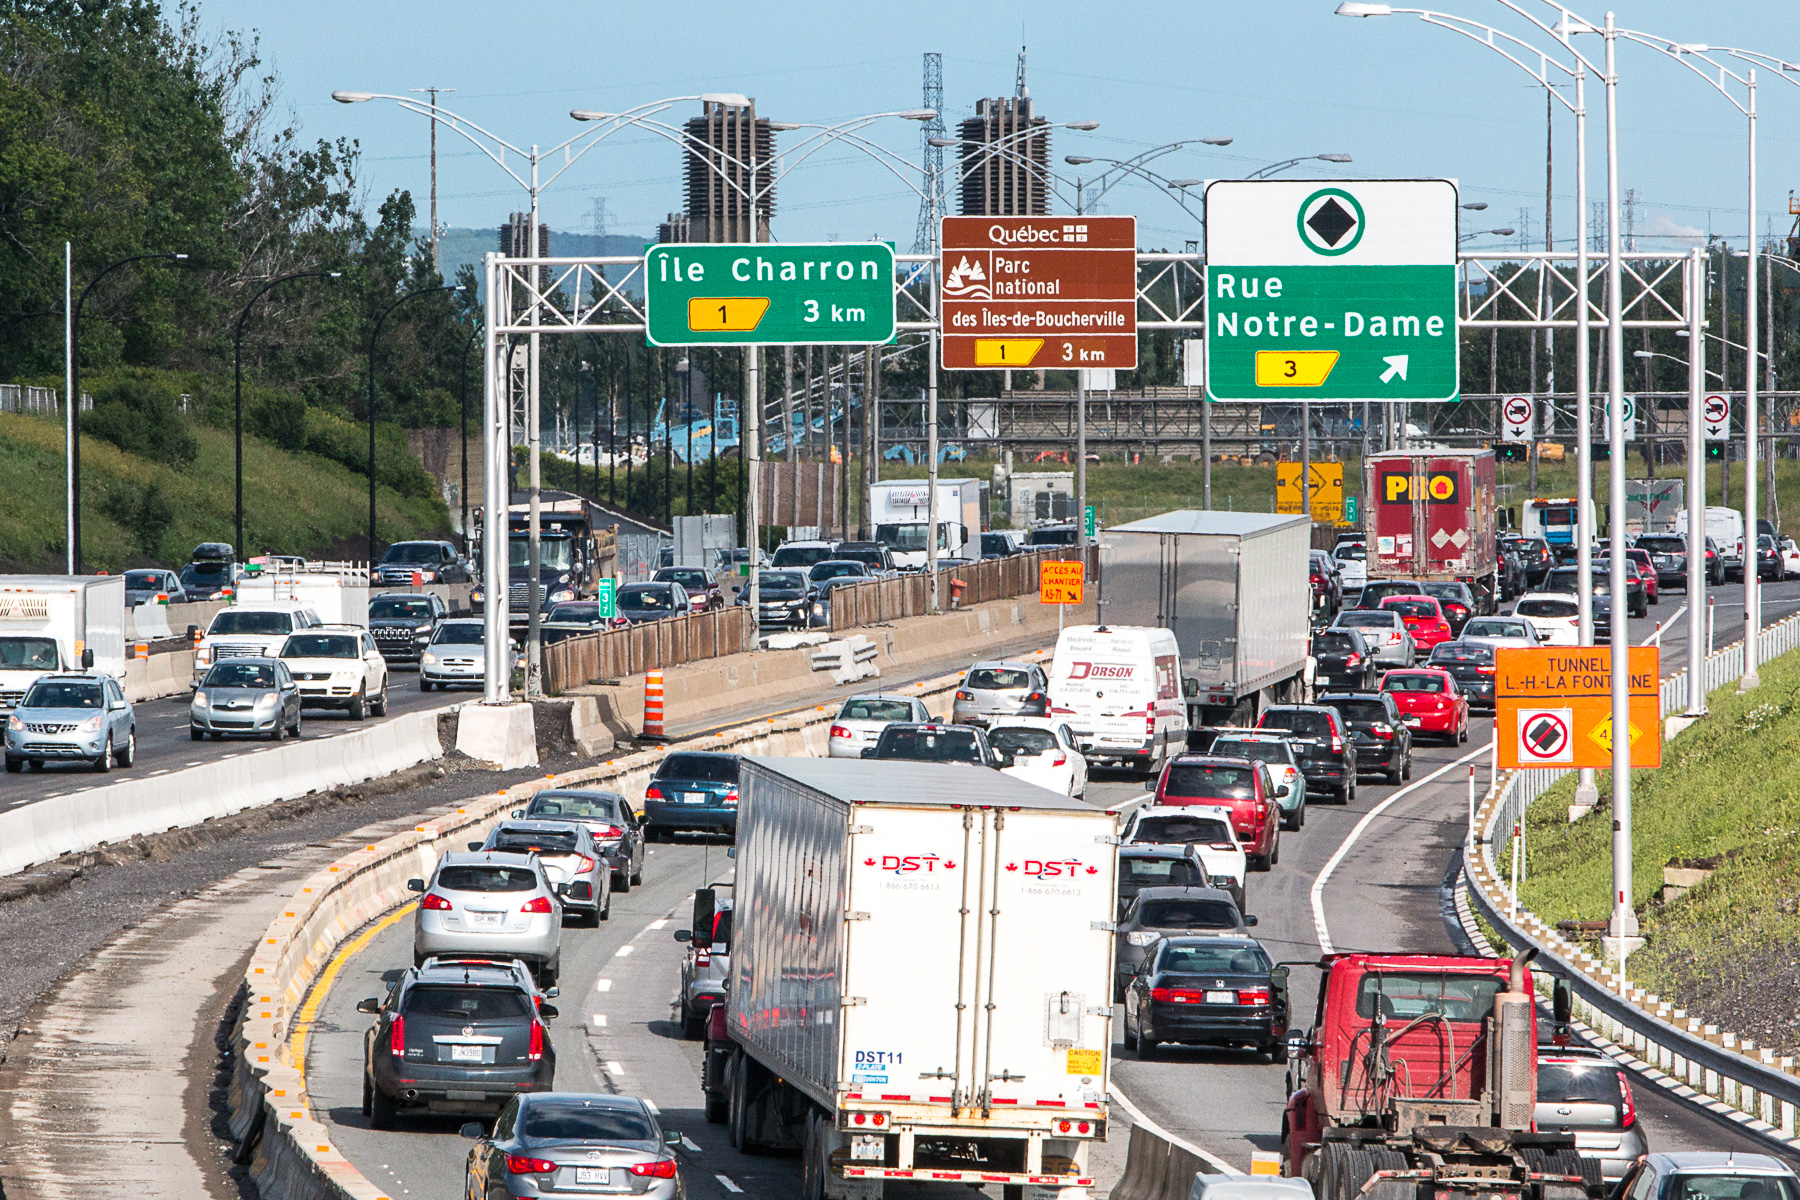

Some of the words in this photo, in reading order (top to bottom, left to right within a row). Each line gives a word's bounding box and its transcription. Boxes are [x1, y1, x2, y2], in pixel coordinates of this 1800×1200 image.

[988, 224, 1060, 246] Québec
[658, 253, 704, 282] Île
[732, 256, 878, 281] Charron
[996, 256, 1030, 274] Parc
[996, 278, 1060, 295] national
[1217, 274, 1283, 298] Rue
[718, 305, 727, 324] 1
[804, 300, 820, 322] 3
[831, 304, 866, 322] km
[952, 310, 978, 327] des
[982, 308, 1126, 327] Îles-de-Boucherville
[1217, 312, 1444, 337] Notre-Dame
[1000, 344, 1006, 360] 1
[1062, 342, 1073, 361] 3
[1080, 348, 1104, 361] km
[1284, 360, 1297, 378] 3
[602, 592, 609, 602] 3
[1066, 662, 1134, 680] DORSON
[1548, 658, 1609, 672] TUNNEL
[1506, 675, 1567, 690] L.-H.-LA
[882, 856, 940, 872] DST
[1024, 860, 1082, 877] DST
[880, 882, 940, 891] 1-866-670-6613
[1021, 887, 1081, 896] 1-866-670-6613
[856, 1050, 902, 1064] DST11
